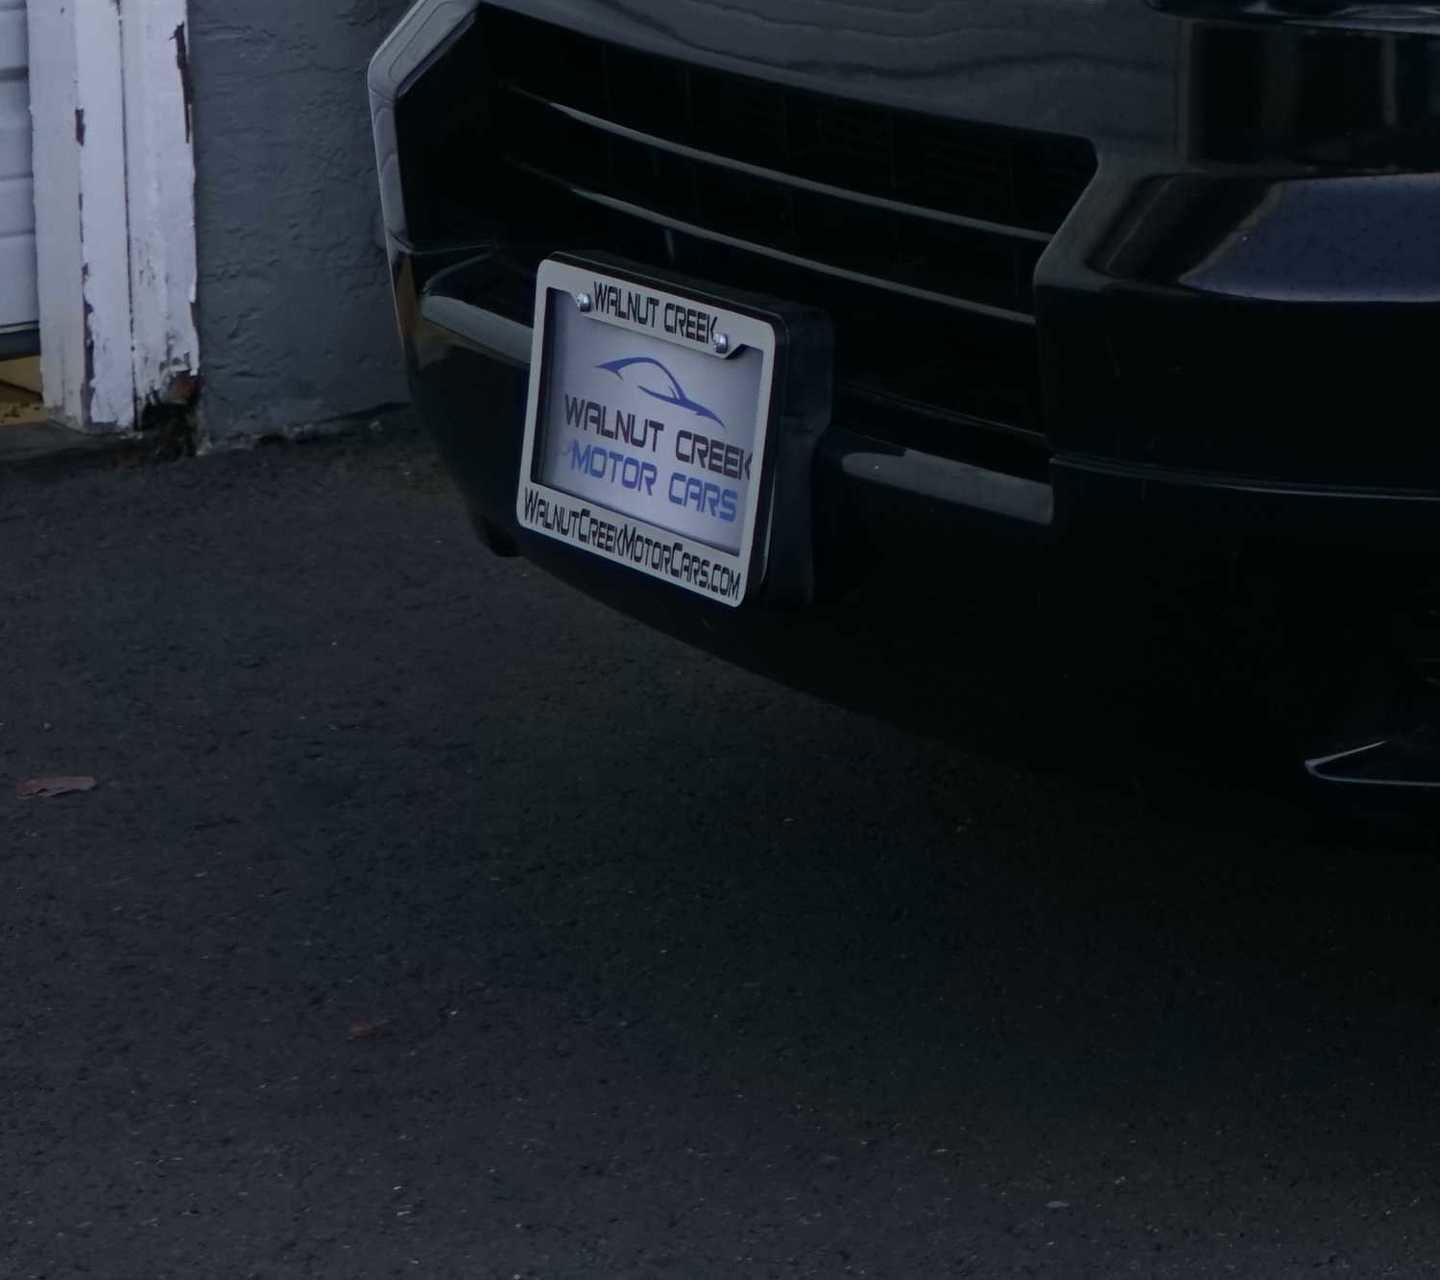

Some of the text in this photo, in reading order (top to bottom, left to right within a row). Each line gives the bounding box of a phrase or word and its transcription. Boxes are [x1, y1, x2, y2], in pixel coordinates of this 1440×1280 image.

[593, 281, 718, 344] WALNUT CREEK
[565, 394, 753, 481] WALNUT CREEK
[570, 441, 737, 522] MOTOR CARS
